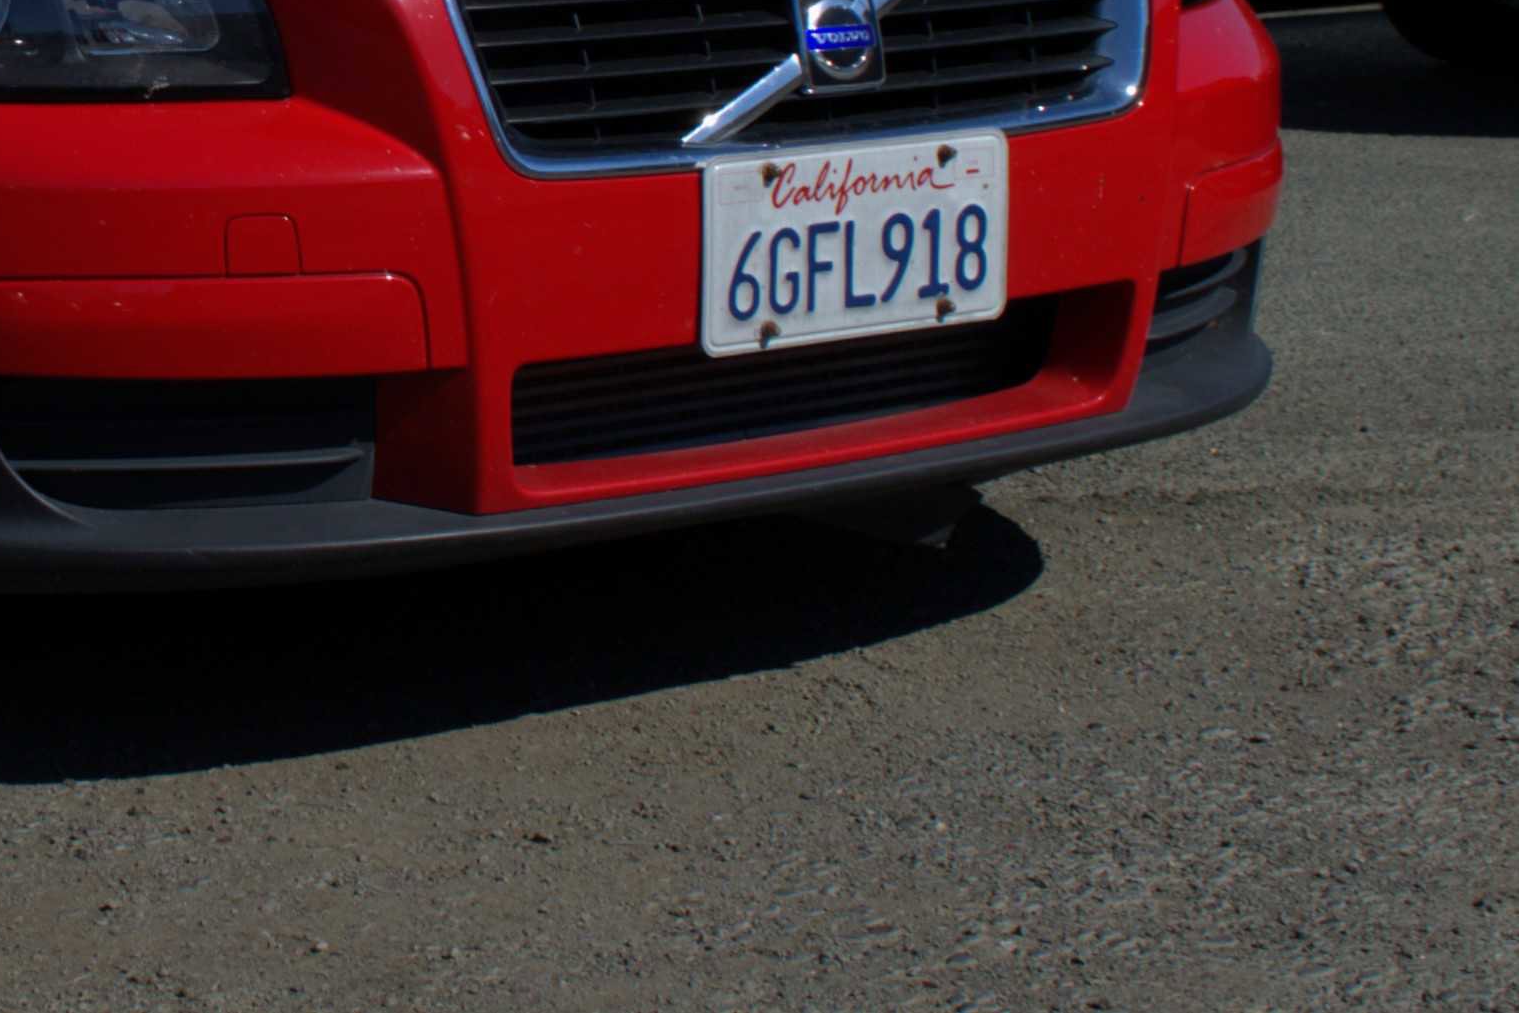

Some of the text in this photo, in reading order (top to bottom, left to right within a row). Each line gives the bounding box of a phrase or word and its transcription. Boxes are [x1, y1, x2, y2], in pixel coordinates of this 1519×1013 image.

[810, 30, 871, 45] VOLVO
[770, 158, 955, 216] California
[728, 203, 989, 322] 6GFL918
